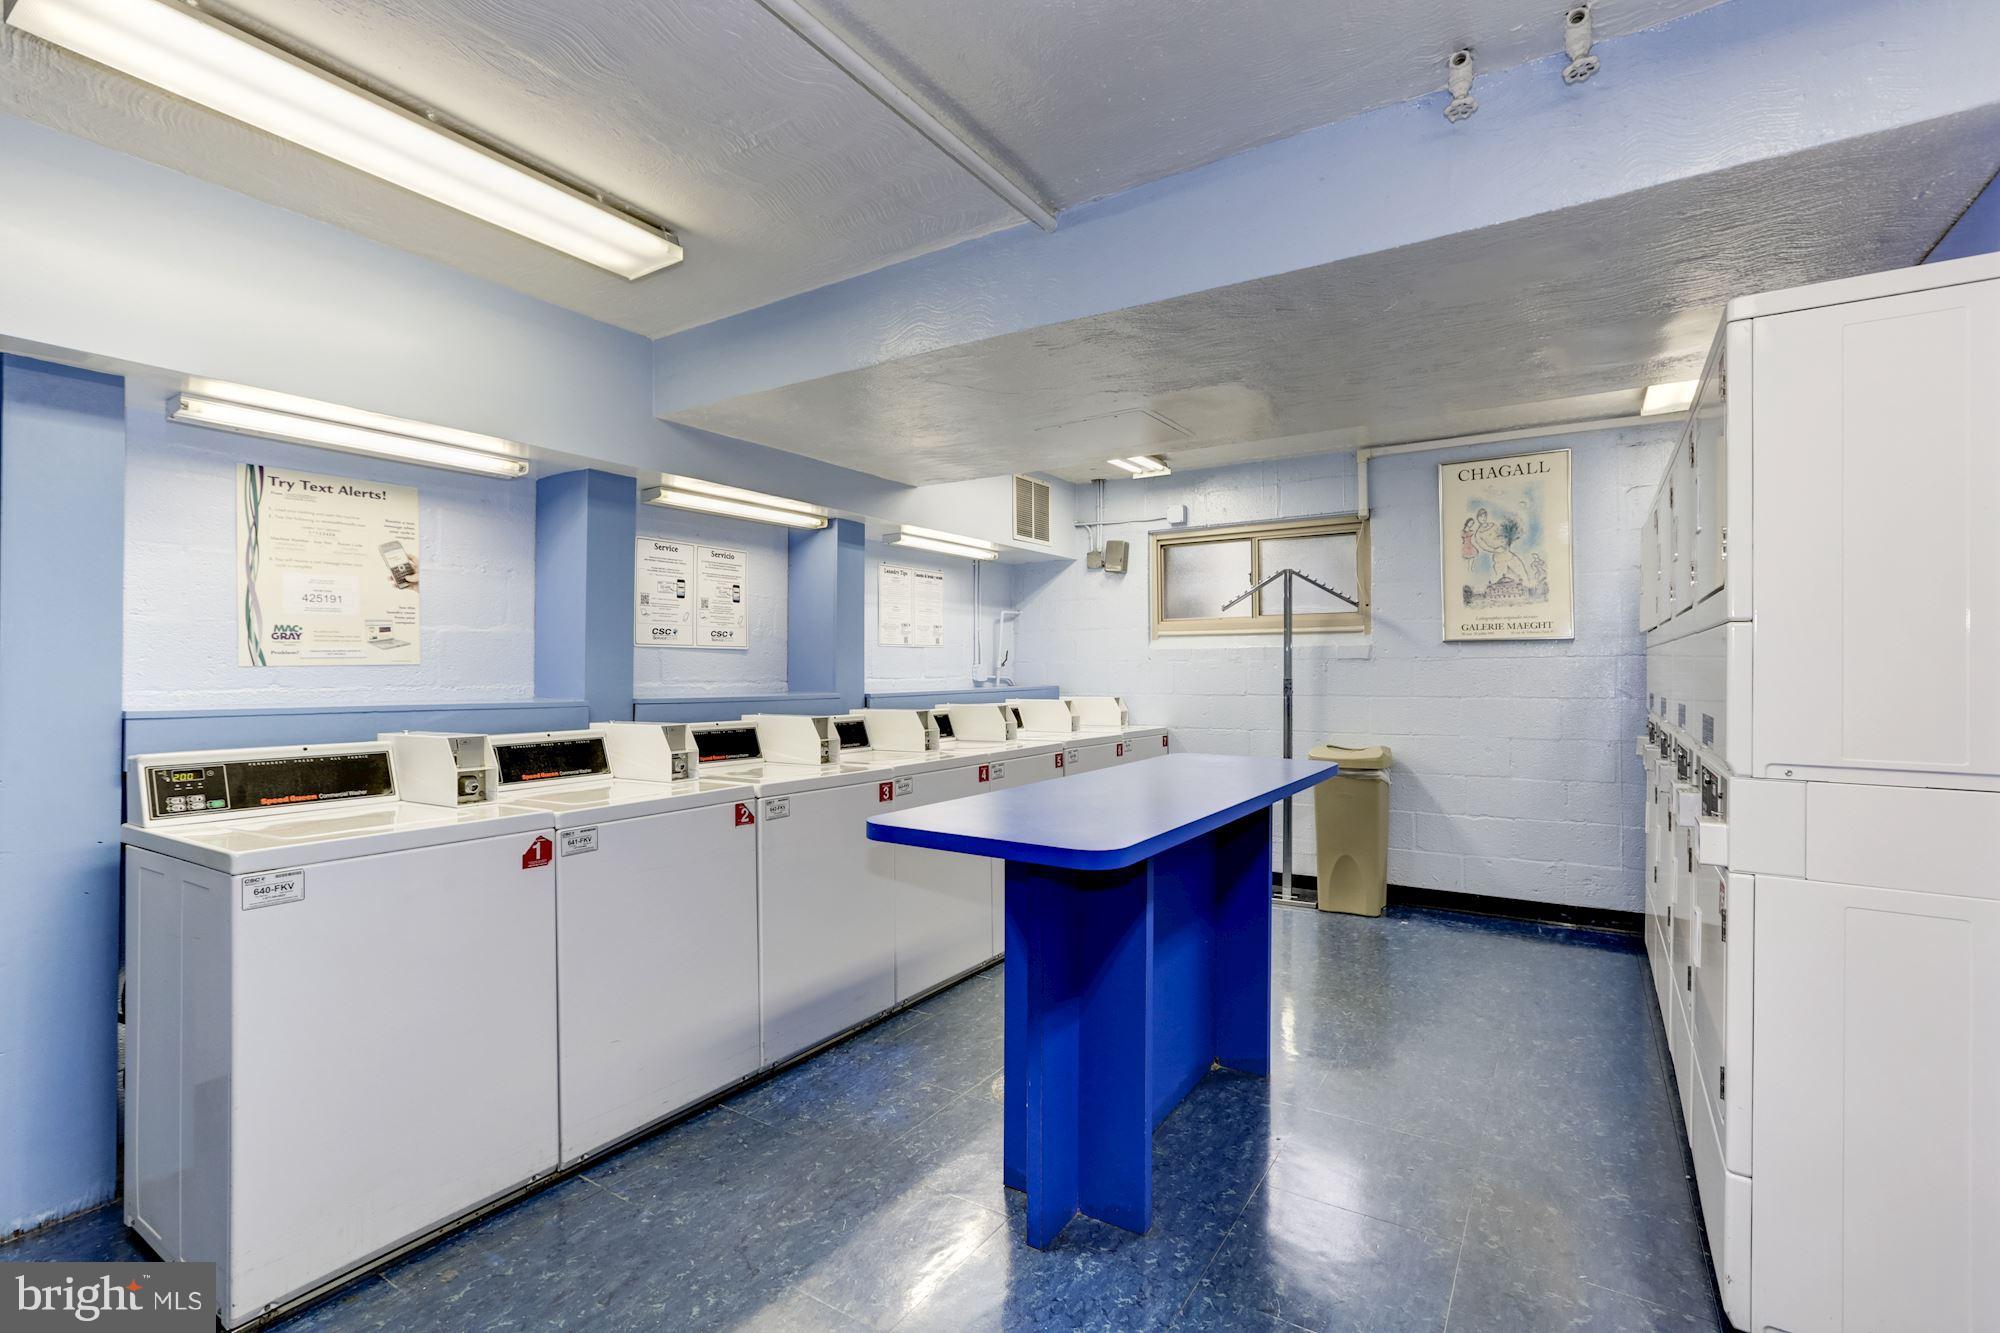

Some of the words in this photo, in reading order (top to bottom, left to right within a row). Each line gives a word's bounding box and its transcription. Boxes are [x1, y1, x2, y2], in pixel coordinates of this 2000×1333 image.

[1458, 461, 1551, 481] CHAGALL
[267, 475, 295, 492] Try
[299, 479, 334, 494] Text
[337, 486, 387, 500] Alerts!
[654, 543, 679, 553] Service
[710, 551, 735, 560] Servicio
[301, 593, 343, 604] 425191
[652, 627, 672, 636] CSC
[1461, 622, 1504, 631] GALERIE
[1506, 621, 1554, 630] MAEGHT
[271, 632, 303, 640] GRAY
[981, 769, 987, 780] 4
[883, 786, 889, 799] 3
[741, 808, 750, 822] 2
[567, 836, 592, 846] 641-FKV
[532, 841, 541, 860] 1
[253, 882, 295, 896] 640-FKV
